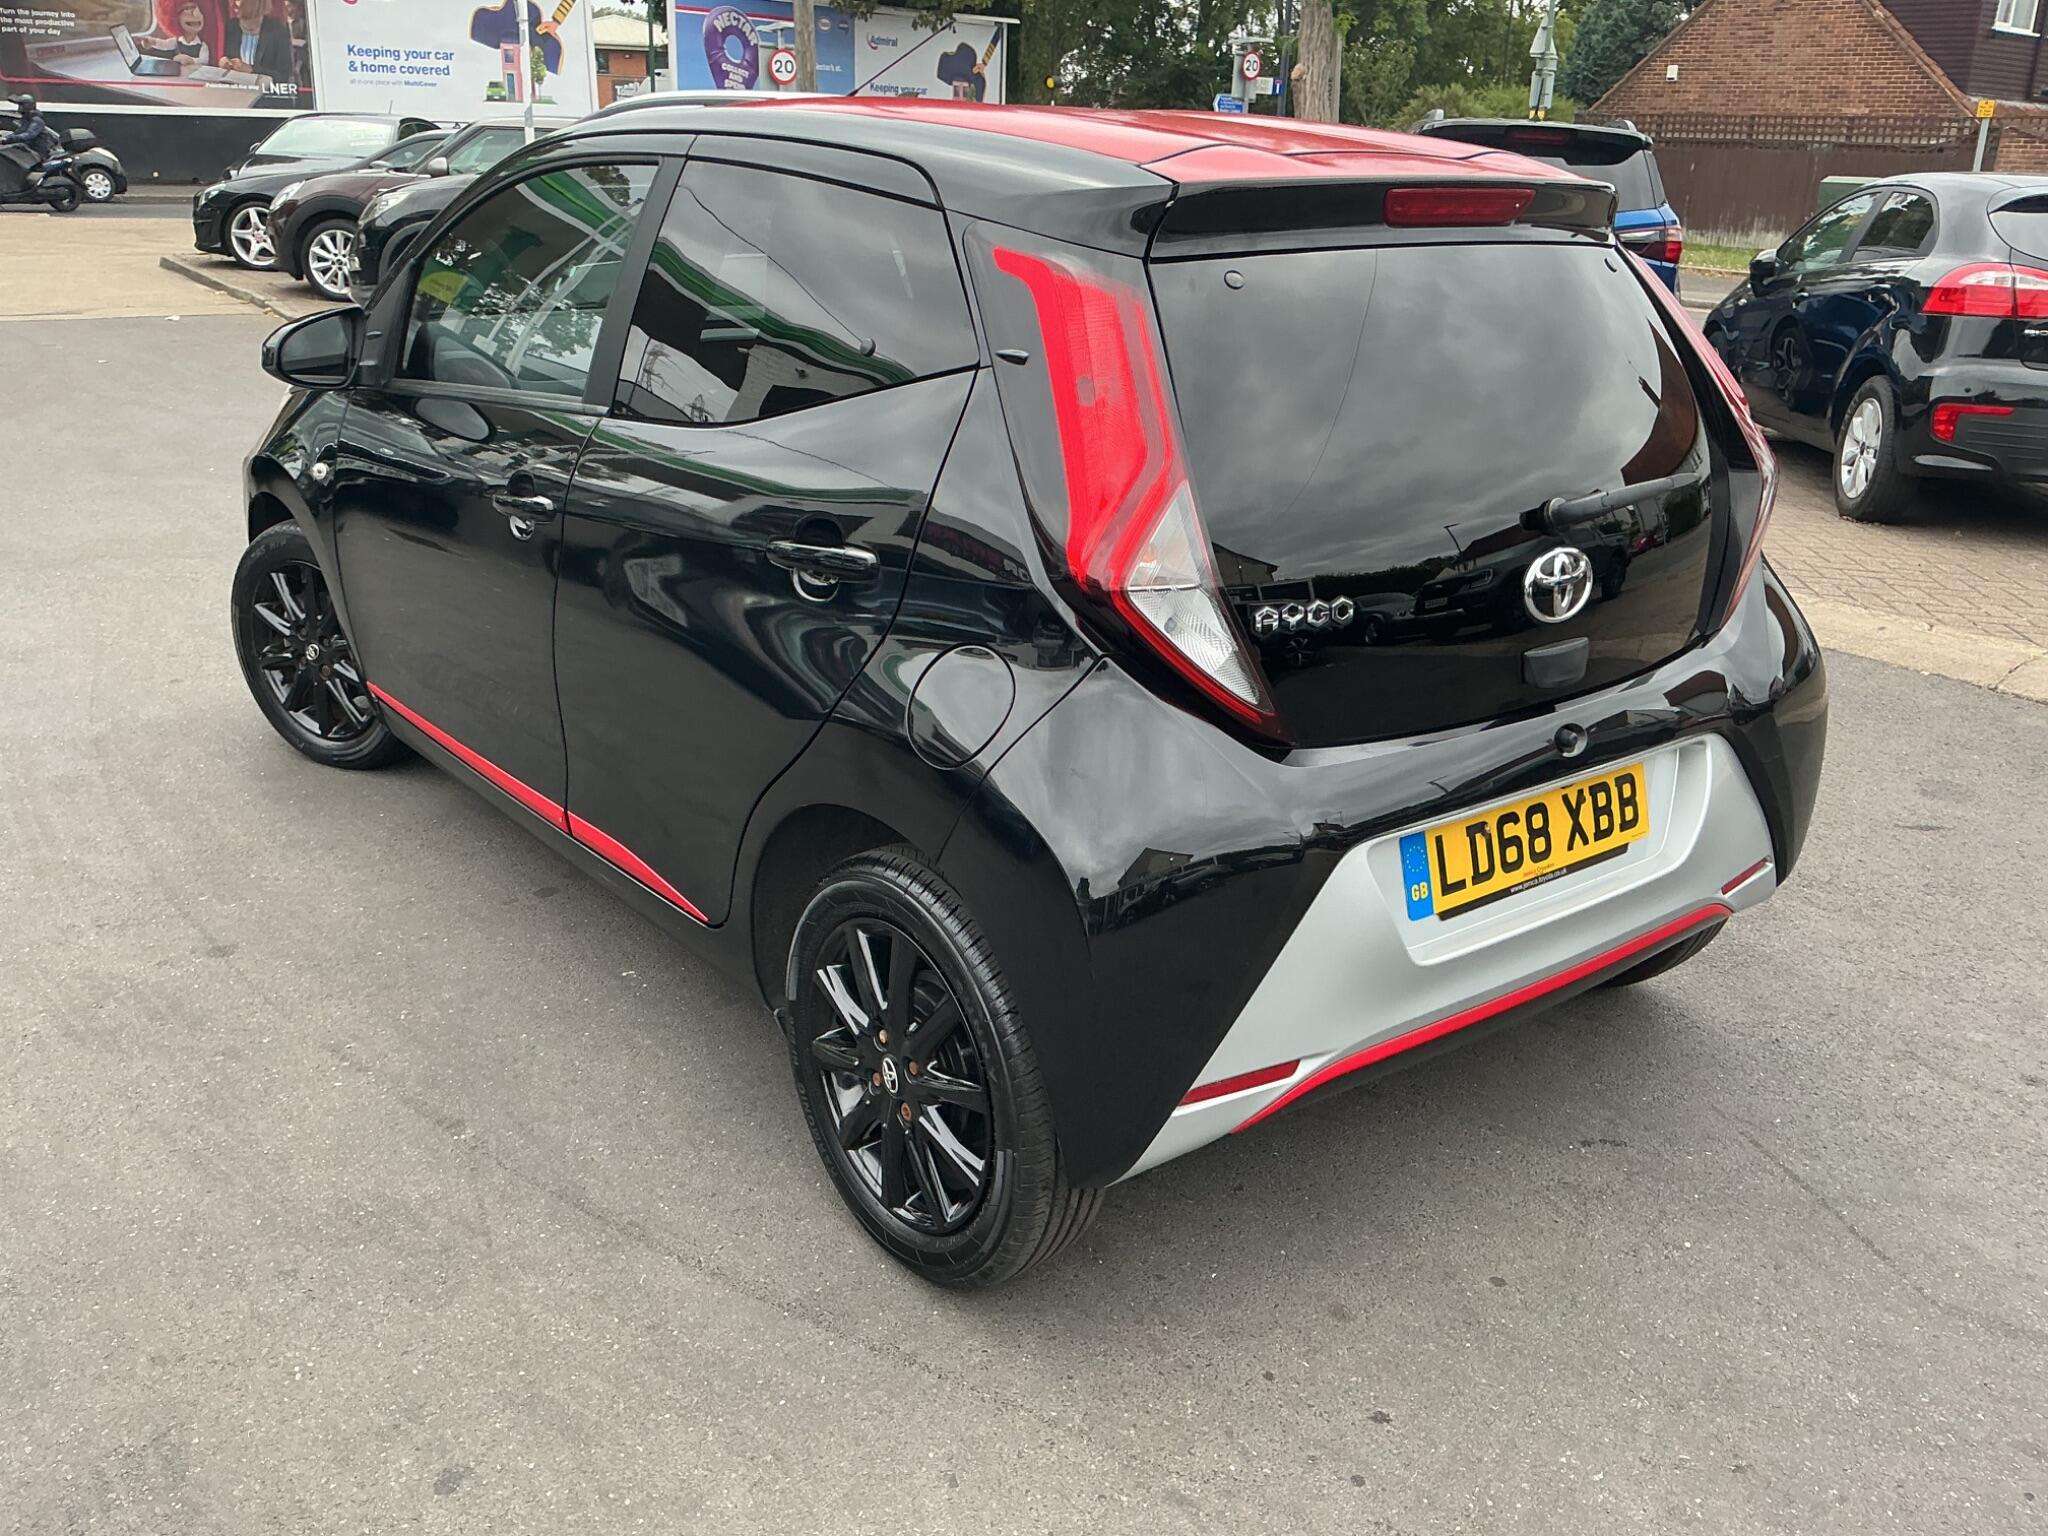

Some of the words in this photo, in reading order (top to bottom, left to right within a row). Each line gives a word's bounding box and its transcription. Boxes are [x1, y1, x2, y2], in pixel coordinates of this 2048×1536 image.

[31, 9, 59, 18] journey
[47, 27, 61, 36] day
[713, 11, 758, 46] NECTAR
[870, 35, 898, 47] Admiral
[347, 44, 400, 60] Keeping
[404, 50, 432, 61] your
[434, 51, 454, 61] car
[348, 60, 358, 72] &
[360, 60, 397, 74] home
[399, 64, 450, 76] covered
[774, 59, 795, 74] 20
[1245, 59, 1259, 72] 20
[261, 82, 298, 95] LNER
[869, 81, 899, 95] Keeping
[1255, 595, 1354, 633] AYGO
[1435, 801, 1552, 897] LD68
[1561, 772, 1640, 852] XBB
[1411, 881, 1428, 901] GB
